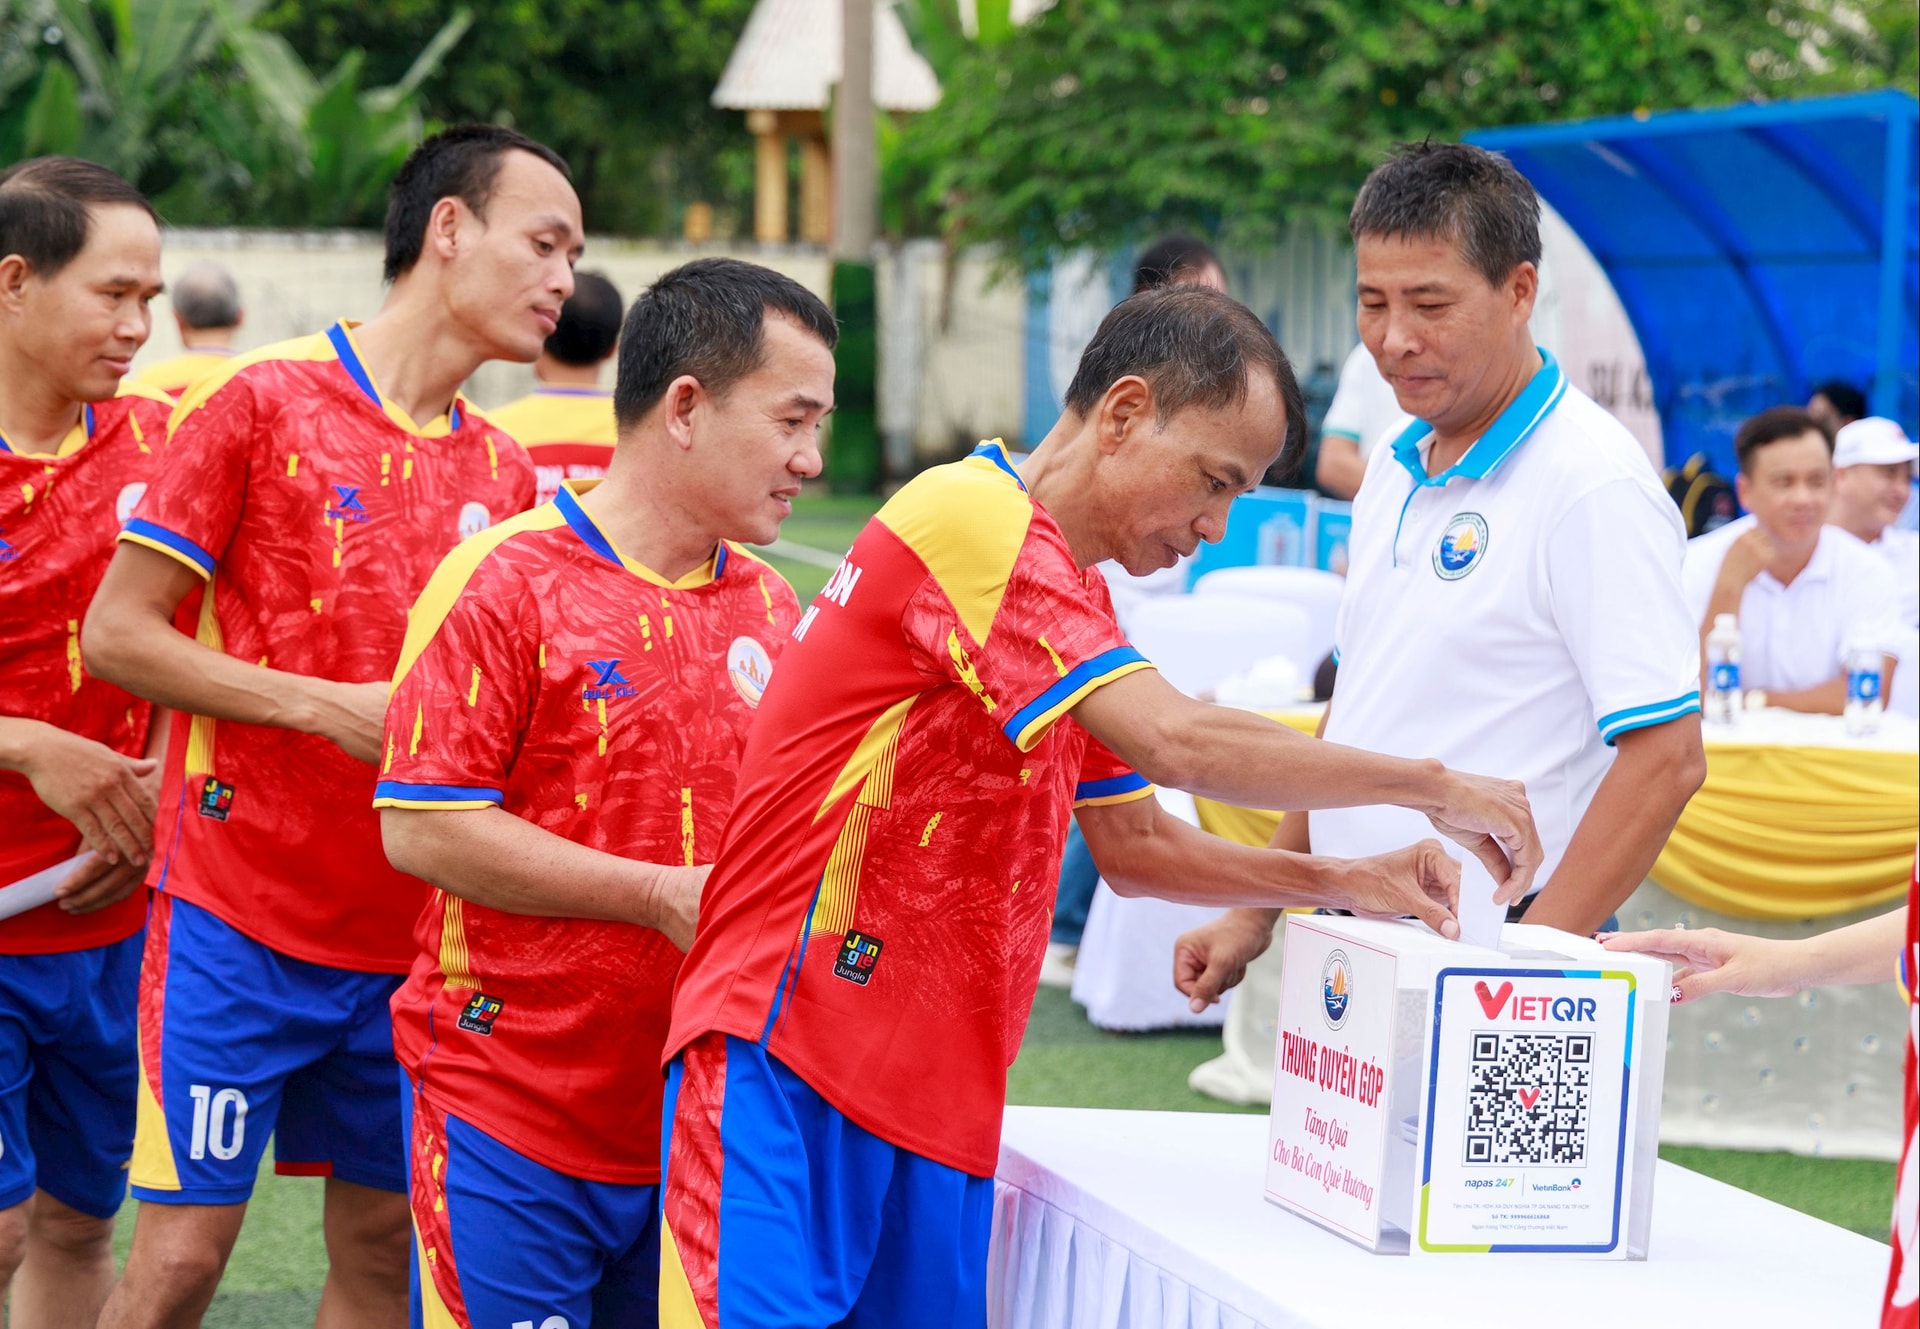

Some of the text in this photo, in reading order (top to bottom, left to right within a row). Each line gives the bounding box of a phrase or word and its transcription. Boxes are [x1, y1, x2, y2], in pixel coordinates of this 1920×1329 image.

[583, 686, 639, 699] BULL KILL
[846, 934, 879, 957] Jun
[836, 965, 866, 982] Jungle
[471, 996, 500, 1013] Jun
[1474, 980, 1597, 1022] VIETQR
[460, 1018, 489, 1032] Jungle
[1281, 1026, 1384, 1108] THÙNG QUYÊN GÓP
[189, 1085, 249, 1160] 10
[1304, 1107, 1348, 1151] Tặng Quà
[1273, 1138, 1374, 1211] Cho Bà Con Quê Hương
[1464, 1178, 1515, 1189] napas 247
[1532, 1183, 1572, 1192] VietinBank
